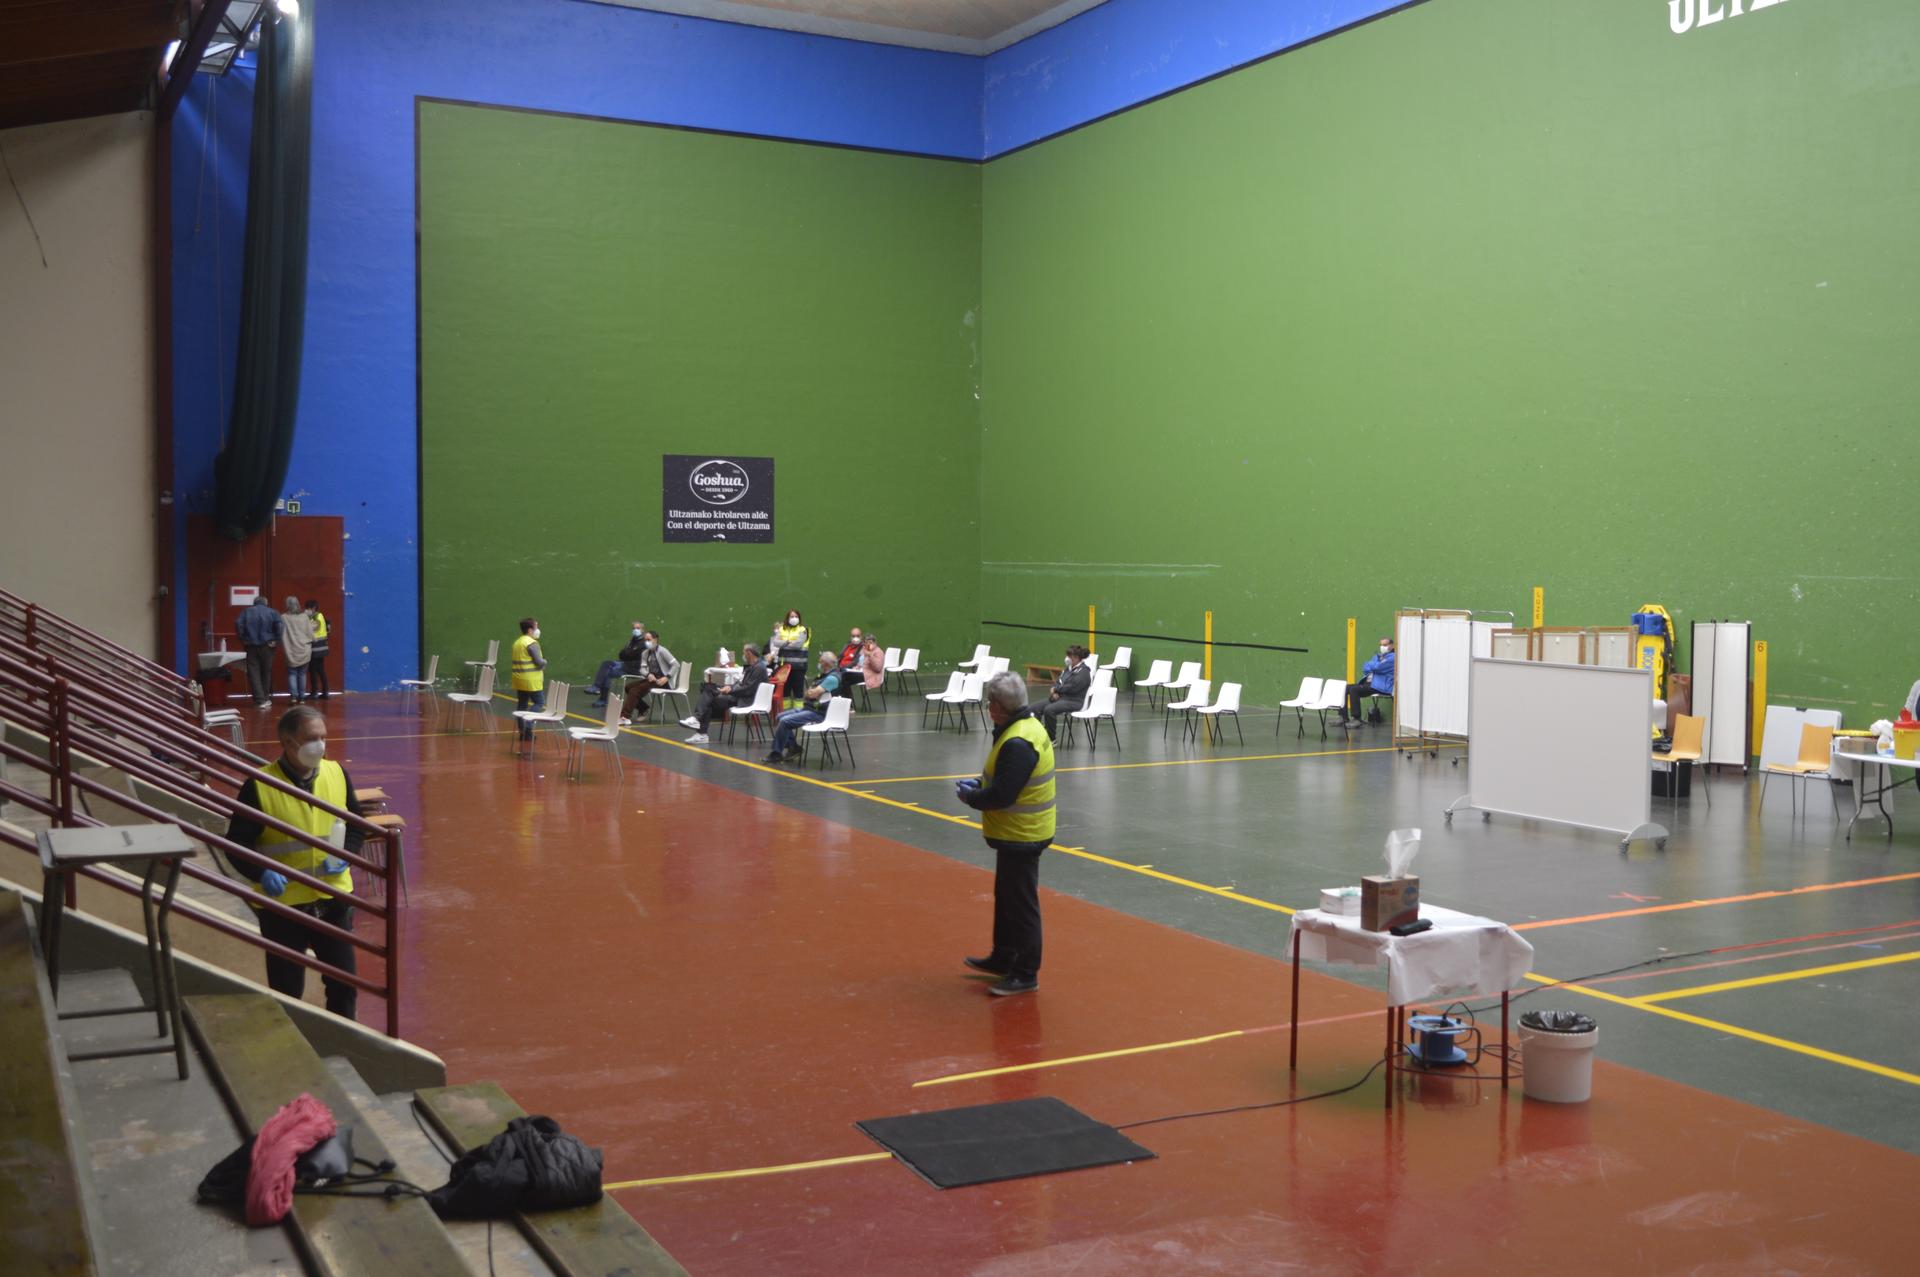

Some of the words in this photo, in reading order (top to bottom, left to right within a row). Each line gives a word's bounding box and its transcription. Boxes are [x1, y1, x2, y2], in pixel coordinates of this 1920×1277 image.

[694, 472, 744, 486] Goshua
[669, 510, 712, 519] Ultzamako
[713, 510, 750, 519] kirolaren
[751, 511, 769, 520] alde
[667, 521, 683, 529] Con
[684, 521, 693, 529] el
[694, 521, 725, 531] deporte
[726, 522, 737, 530] de
[738, 522, 770, 530] Ultzama
[1757, 642, 1764, 652] 6
